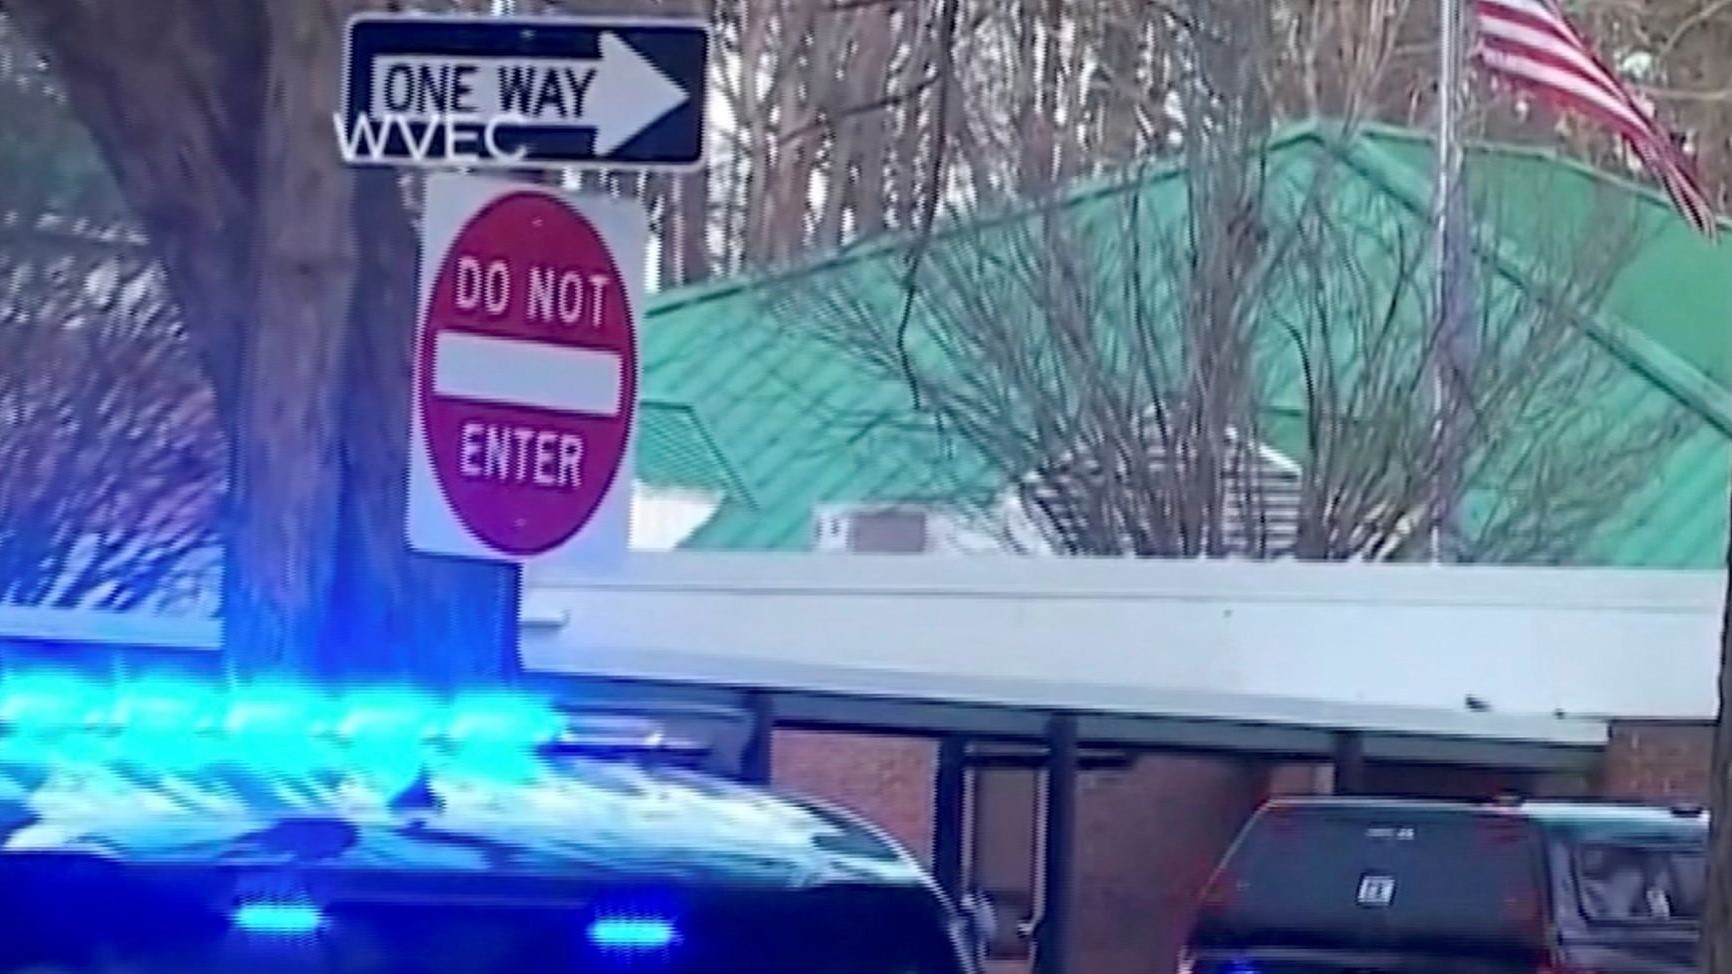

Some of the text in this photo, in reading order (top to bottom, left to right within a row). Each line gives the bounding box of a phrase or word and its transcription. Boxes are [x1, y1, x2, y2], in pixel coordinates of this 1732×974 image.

[384, 64, 597, 117] ONE WAY
[456, 257, 609, 325] DO NOT
[460, 423, 584, 488] ENTER
